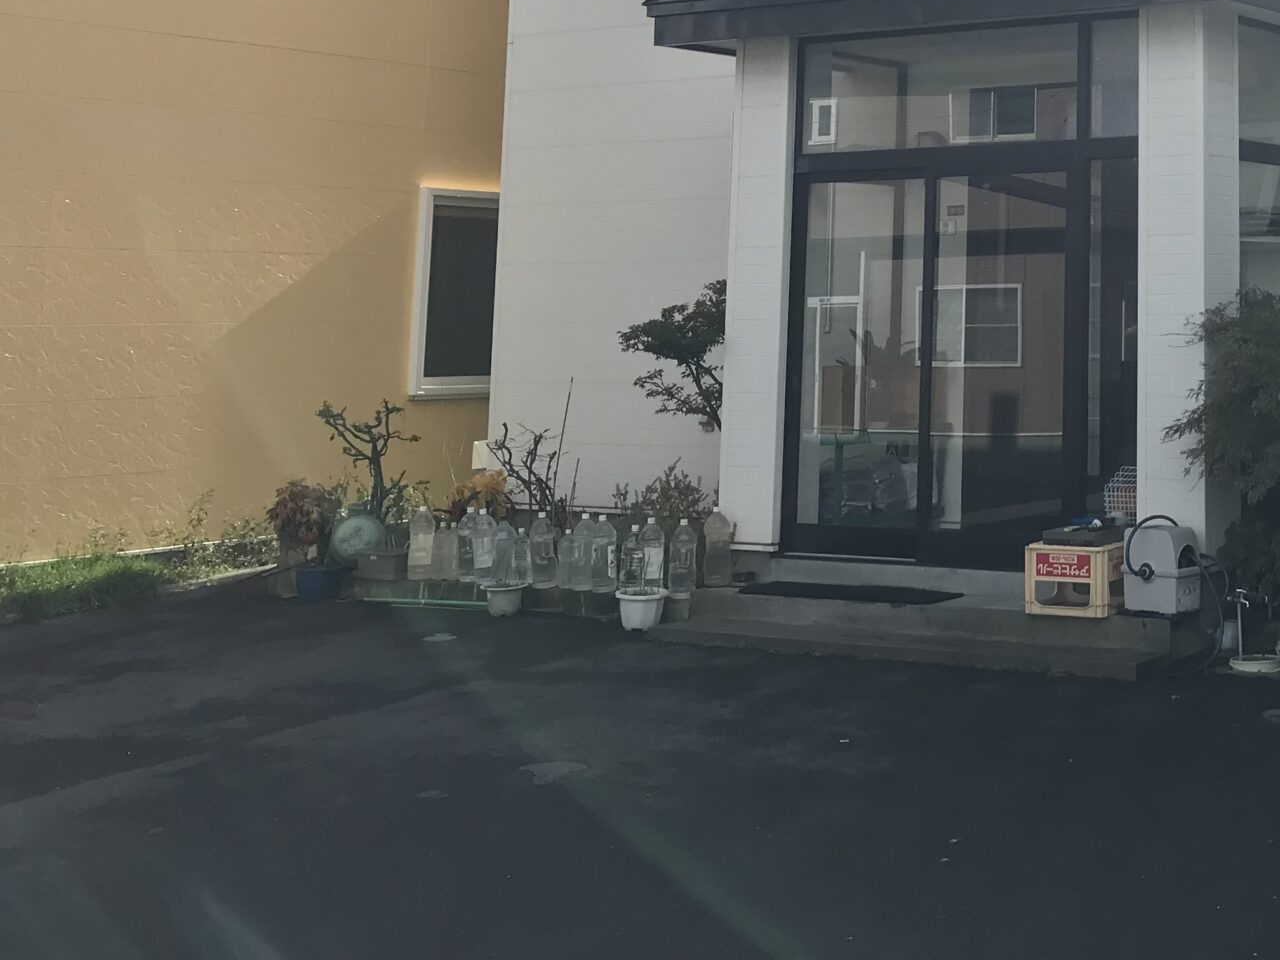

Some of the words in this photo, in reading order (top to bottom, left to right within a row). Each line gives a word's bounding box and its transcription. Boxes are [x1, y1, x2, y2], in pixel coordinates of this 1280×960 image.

[1037, 563, 1089, 576] アサヒビール
